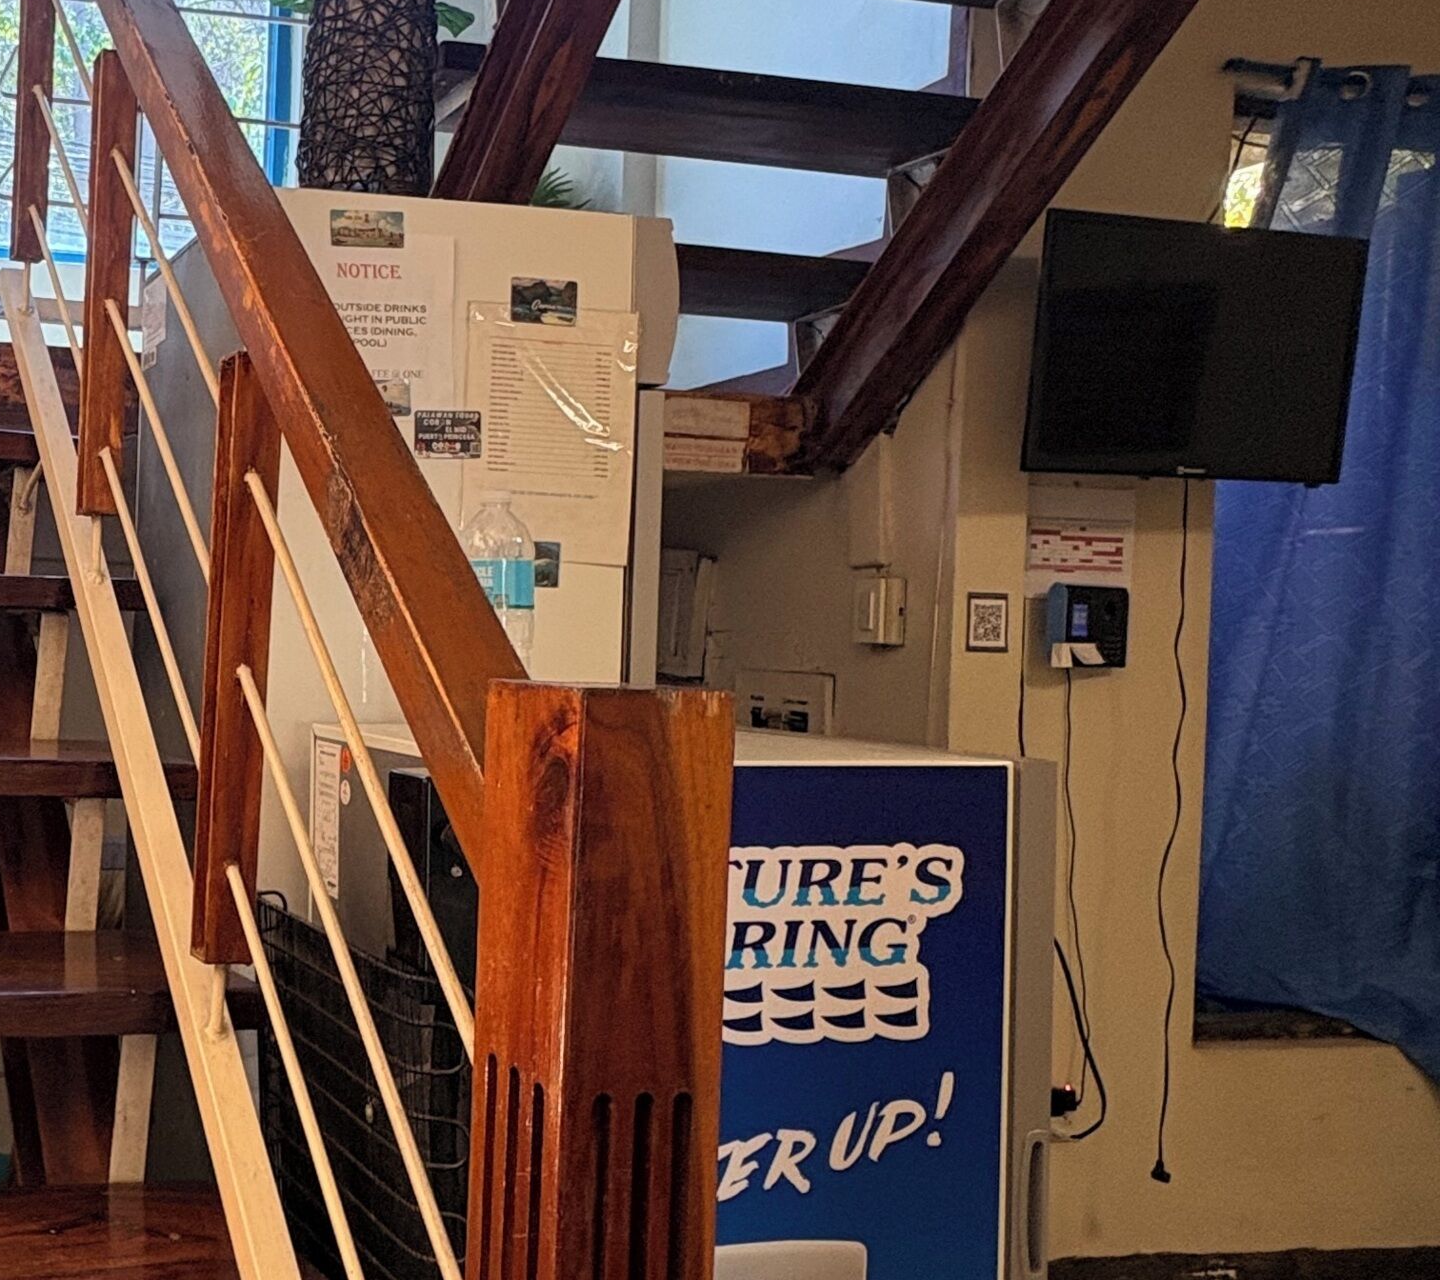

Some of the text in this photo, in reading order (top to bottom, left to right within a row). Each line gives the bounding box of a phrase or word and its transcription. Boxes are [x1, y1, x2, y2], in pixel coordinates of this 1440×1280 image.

[336, 262, 402, 280] NOTICE
[383, 304, 427, 314] DRINKS
[371, 314, 383, 325] IN
[385, 315, 427, 325] PUBLIC
[829, 1071, 954, 1172] UP!
